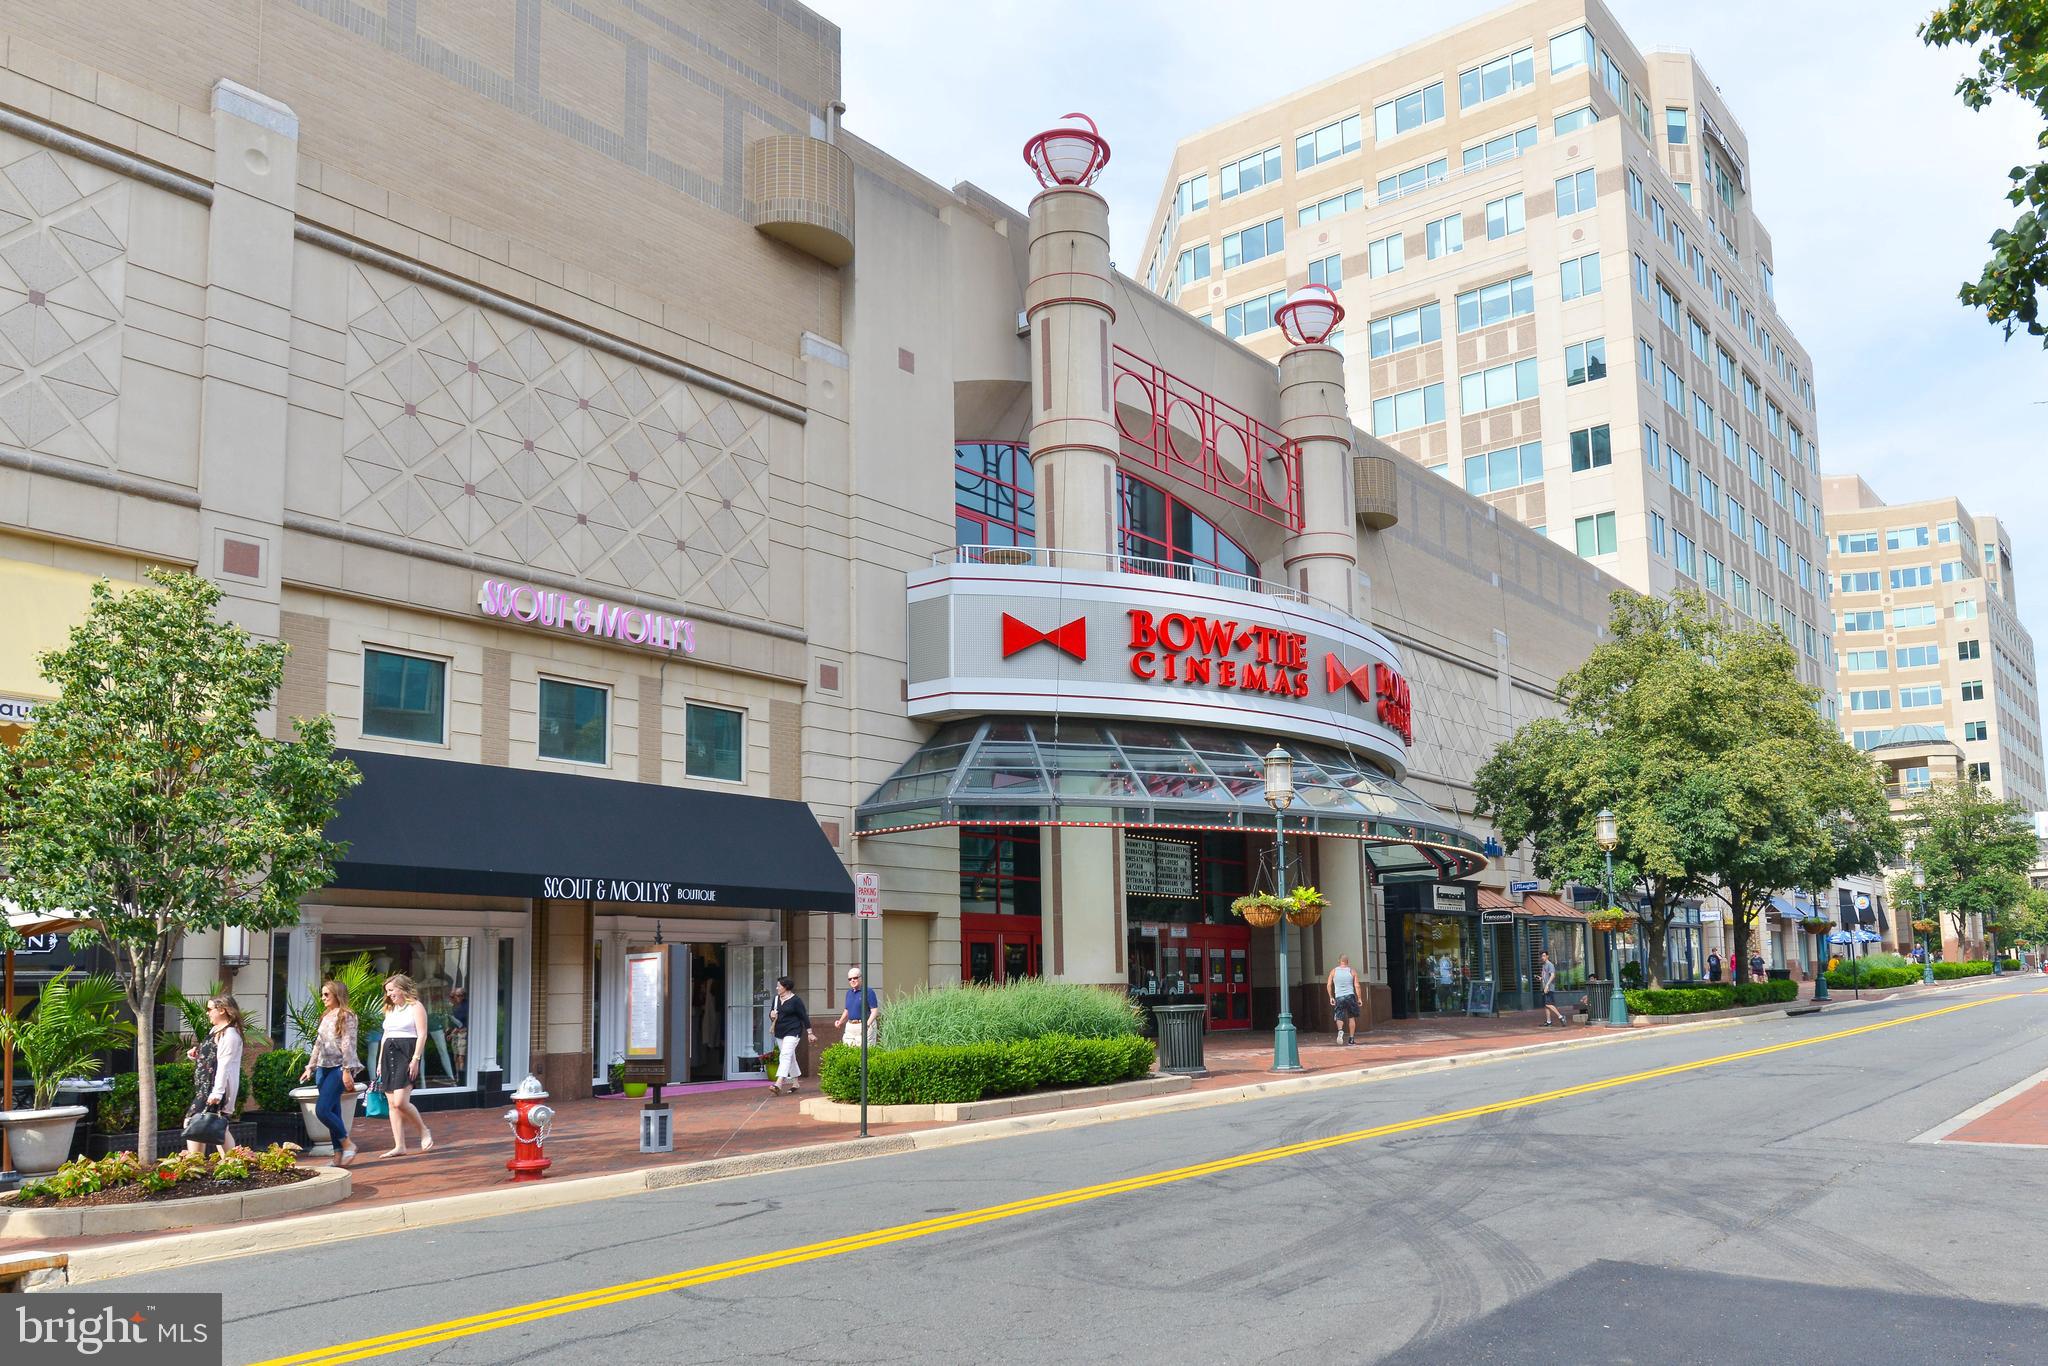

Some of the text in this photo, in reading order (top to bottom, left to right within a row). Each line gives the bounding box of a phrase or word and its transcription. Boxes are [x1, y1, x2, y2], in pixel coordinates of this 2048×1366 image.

[482, 578, 697, 653] SCOUT & MOLLY'S
[1130, 651, 1310, 698] CINEMAS
[543, 876, 716, 903] SCOUT & MOLLY'S BOUTIQUE
[858, 887, 877, 896] PARKING
[863, 876, 872, 886] NO
